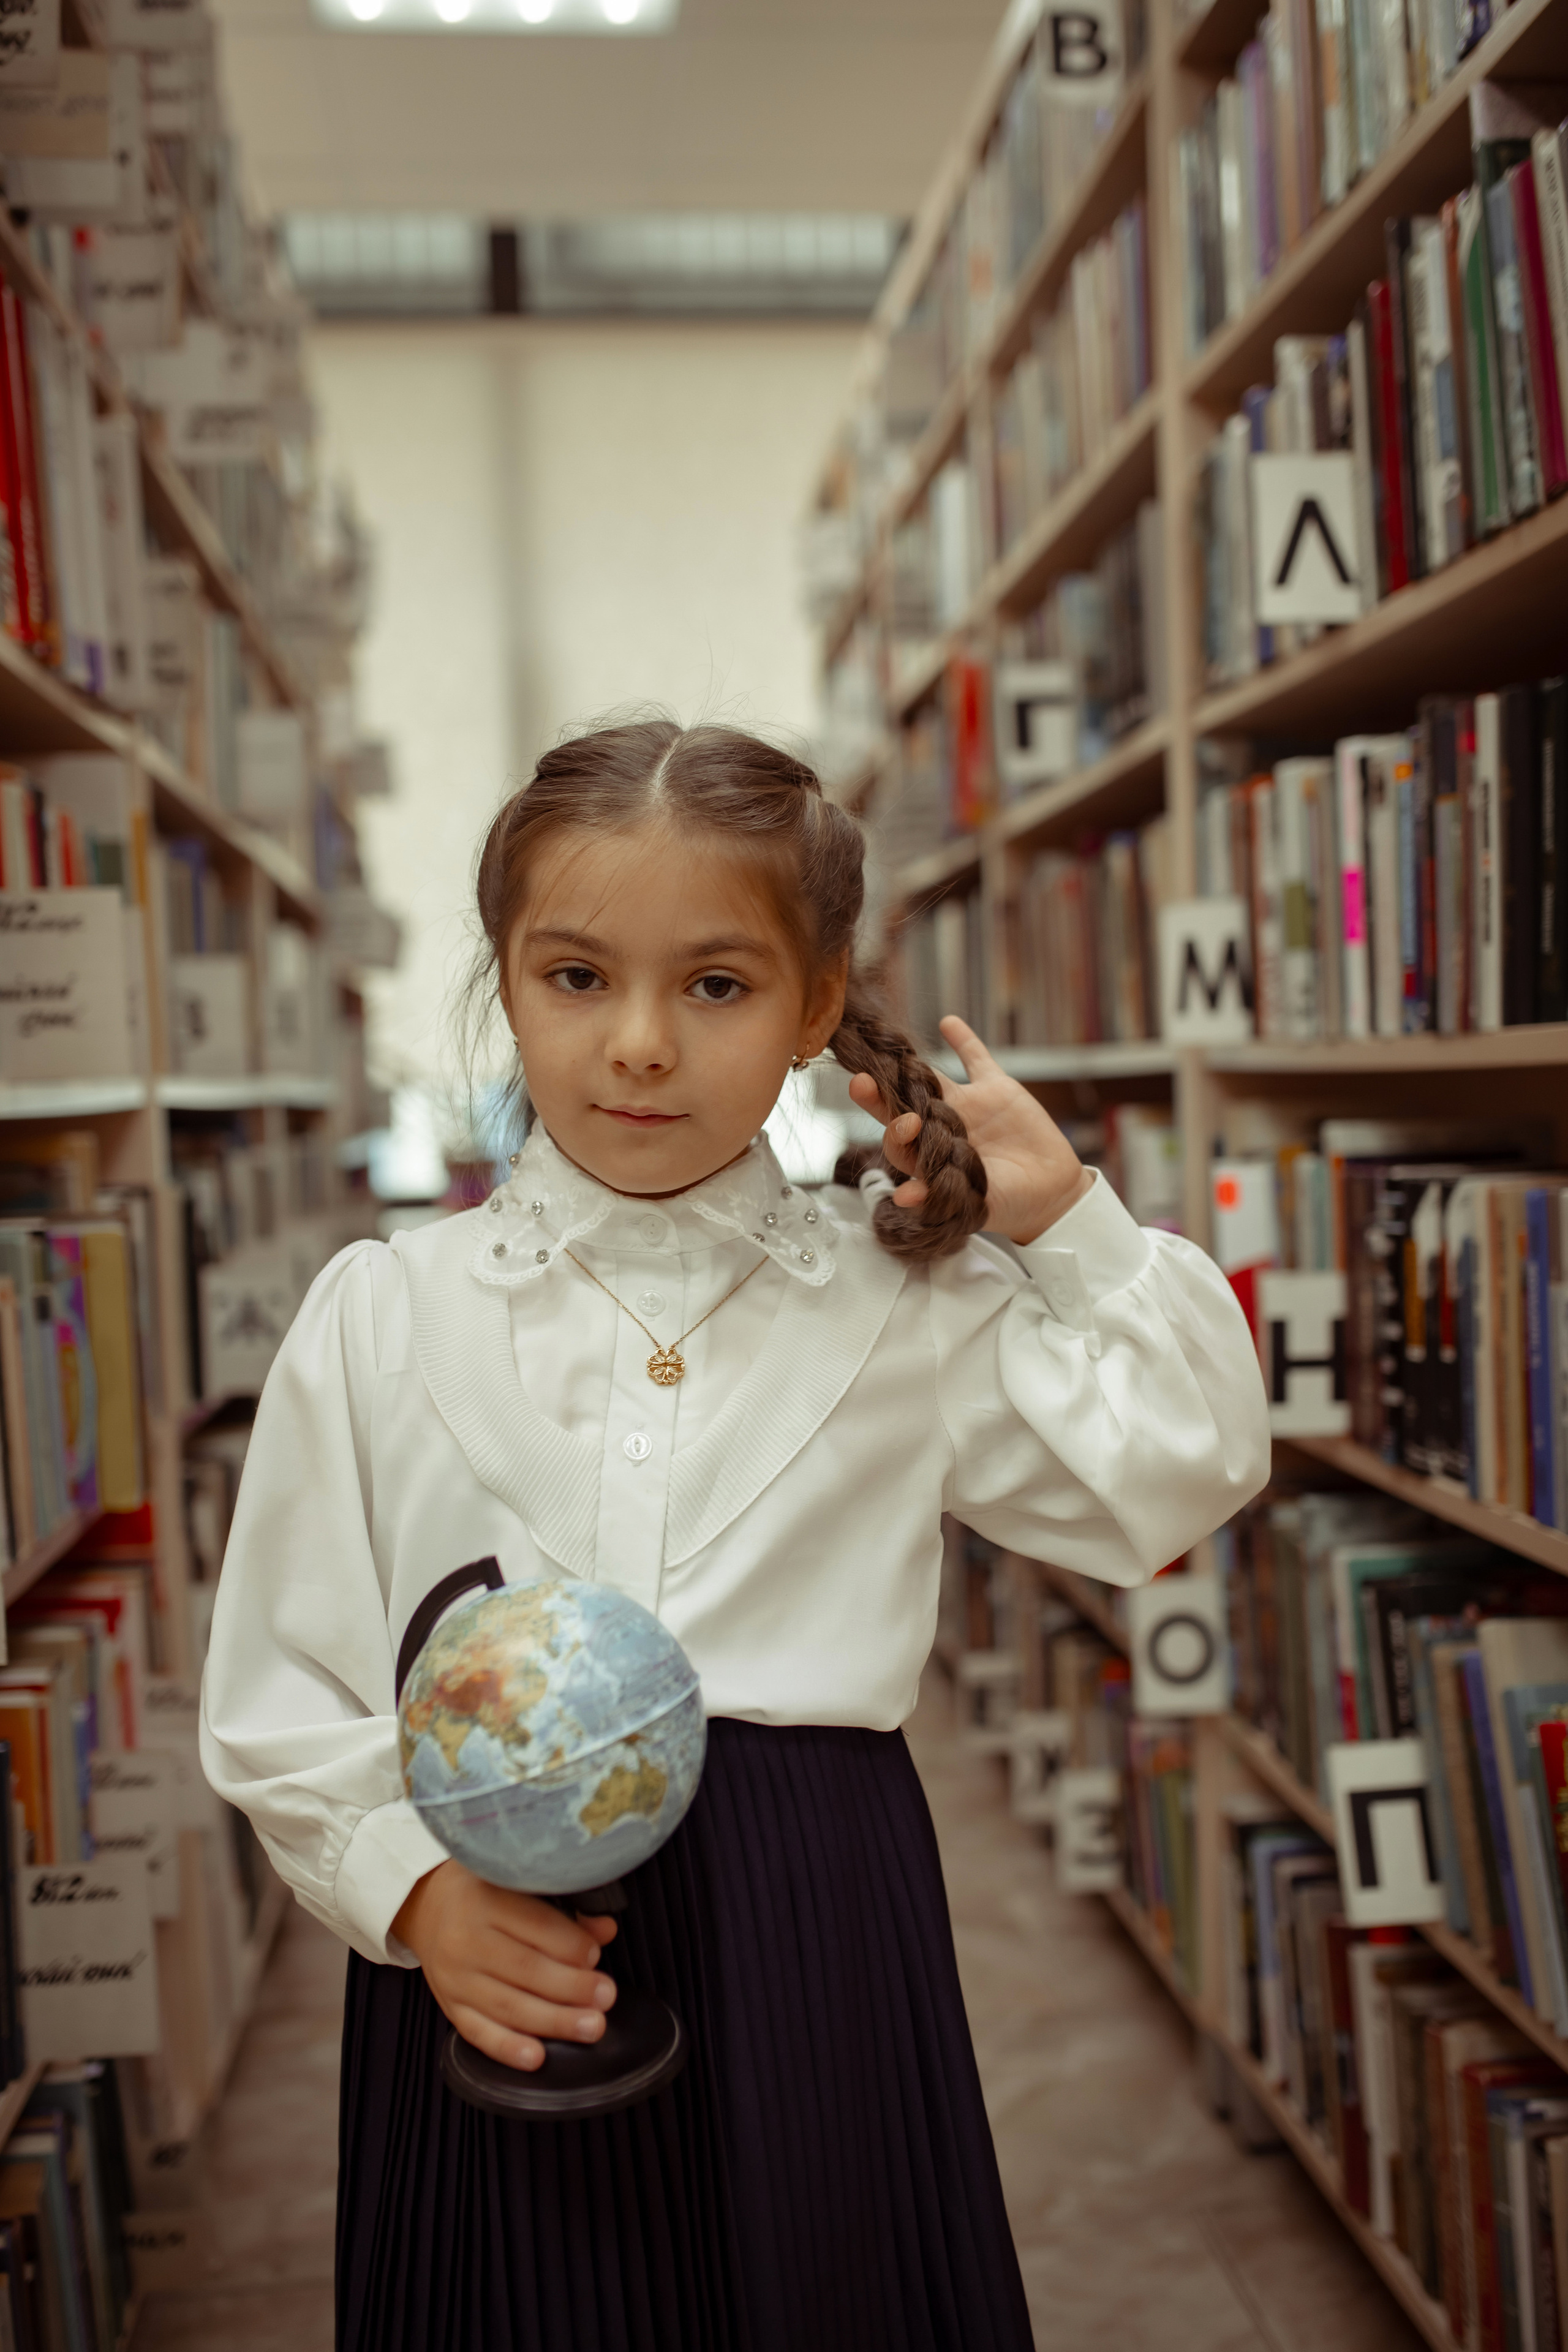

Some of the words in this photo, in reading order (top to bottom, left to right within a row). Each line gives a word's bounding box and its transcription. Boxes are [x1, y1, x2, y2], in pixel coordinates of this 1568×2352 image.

[1051, 11, 1109, 77] В
[1274, 497, 1353, 586] Л
[1177, 936, 1254, 1014] М
[1272, 1319, 1346, 1403] Н
[1148, 1612, 1215, 1684] О
[1349, 1787, 1439, 1888] П
